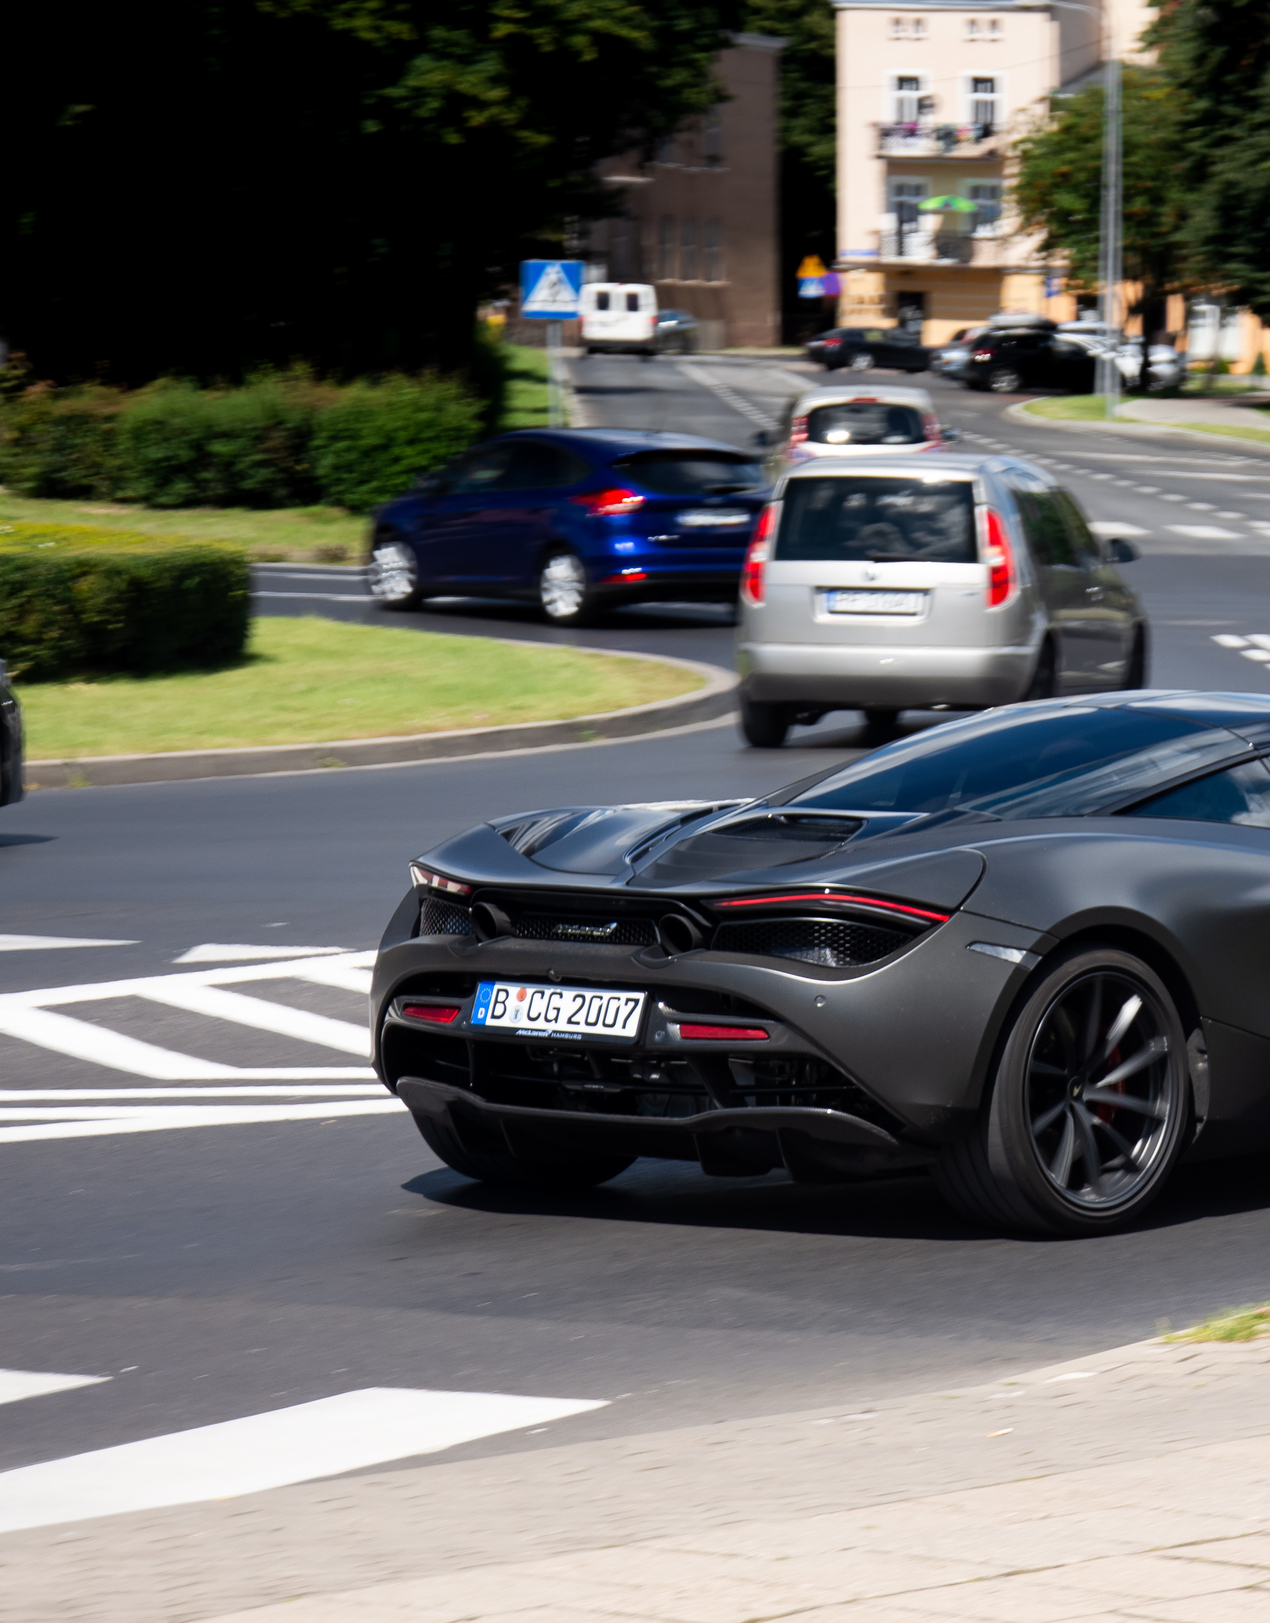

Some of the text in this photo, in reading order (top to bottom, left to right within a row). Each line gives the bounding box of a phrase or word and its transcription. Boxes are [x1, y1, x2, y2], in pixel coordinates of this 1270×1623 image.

[477, 1007, 486, 1019] D
[490, 988, 640, 1029] B CG 2007
[515, 1029, 582, 1040] McLaren HAMBURG
